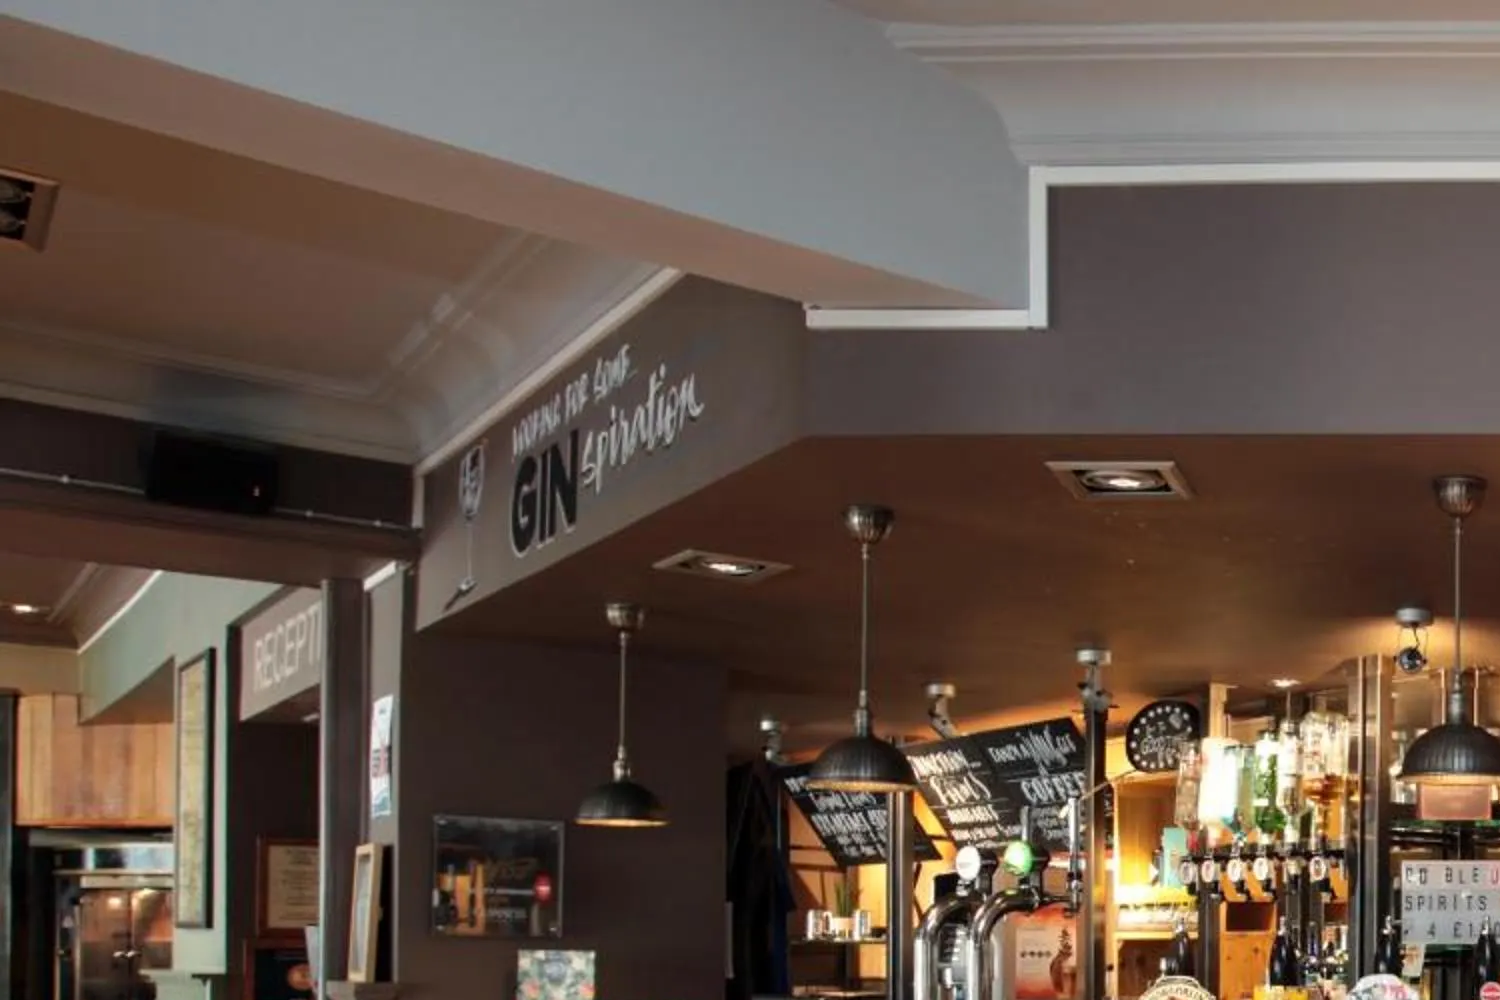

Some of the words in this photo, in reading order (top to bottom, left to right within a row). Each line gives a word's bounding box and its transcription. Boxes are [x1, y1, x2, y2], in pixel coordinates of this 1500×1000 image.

[566, 373, 588, 424] FOR
[594, 344, 637, 402] SOME
[510, 428, 579, 558] GIN
[581, 363, 705, 495] spiration
[254, 602, 322, 693] RECEPTI
[1404, 895, 1487, 911] SPIRITS
